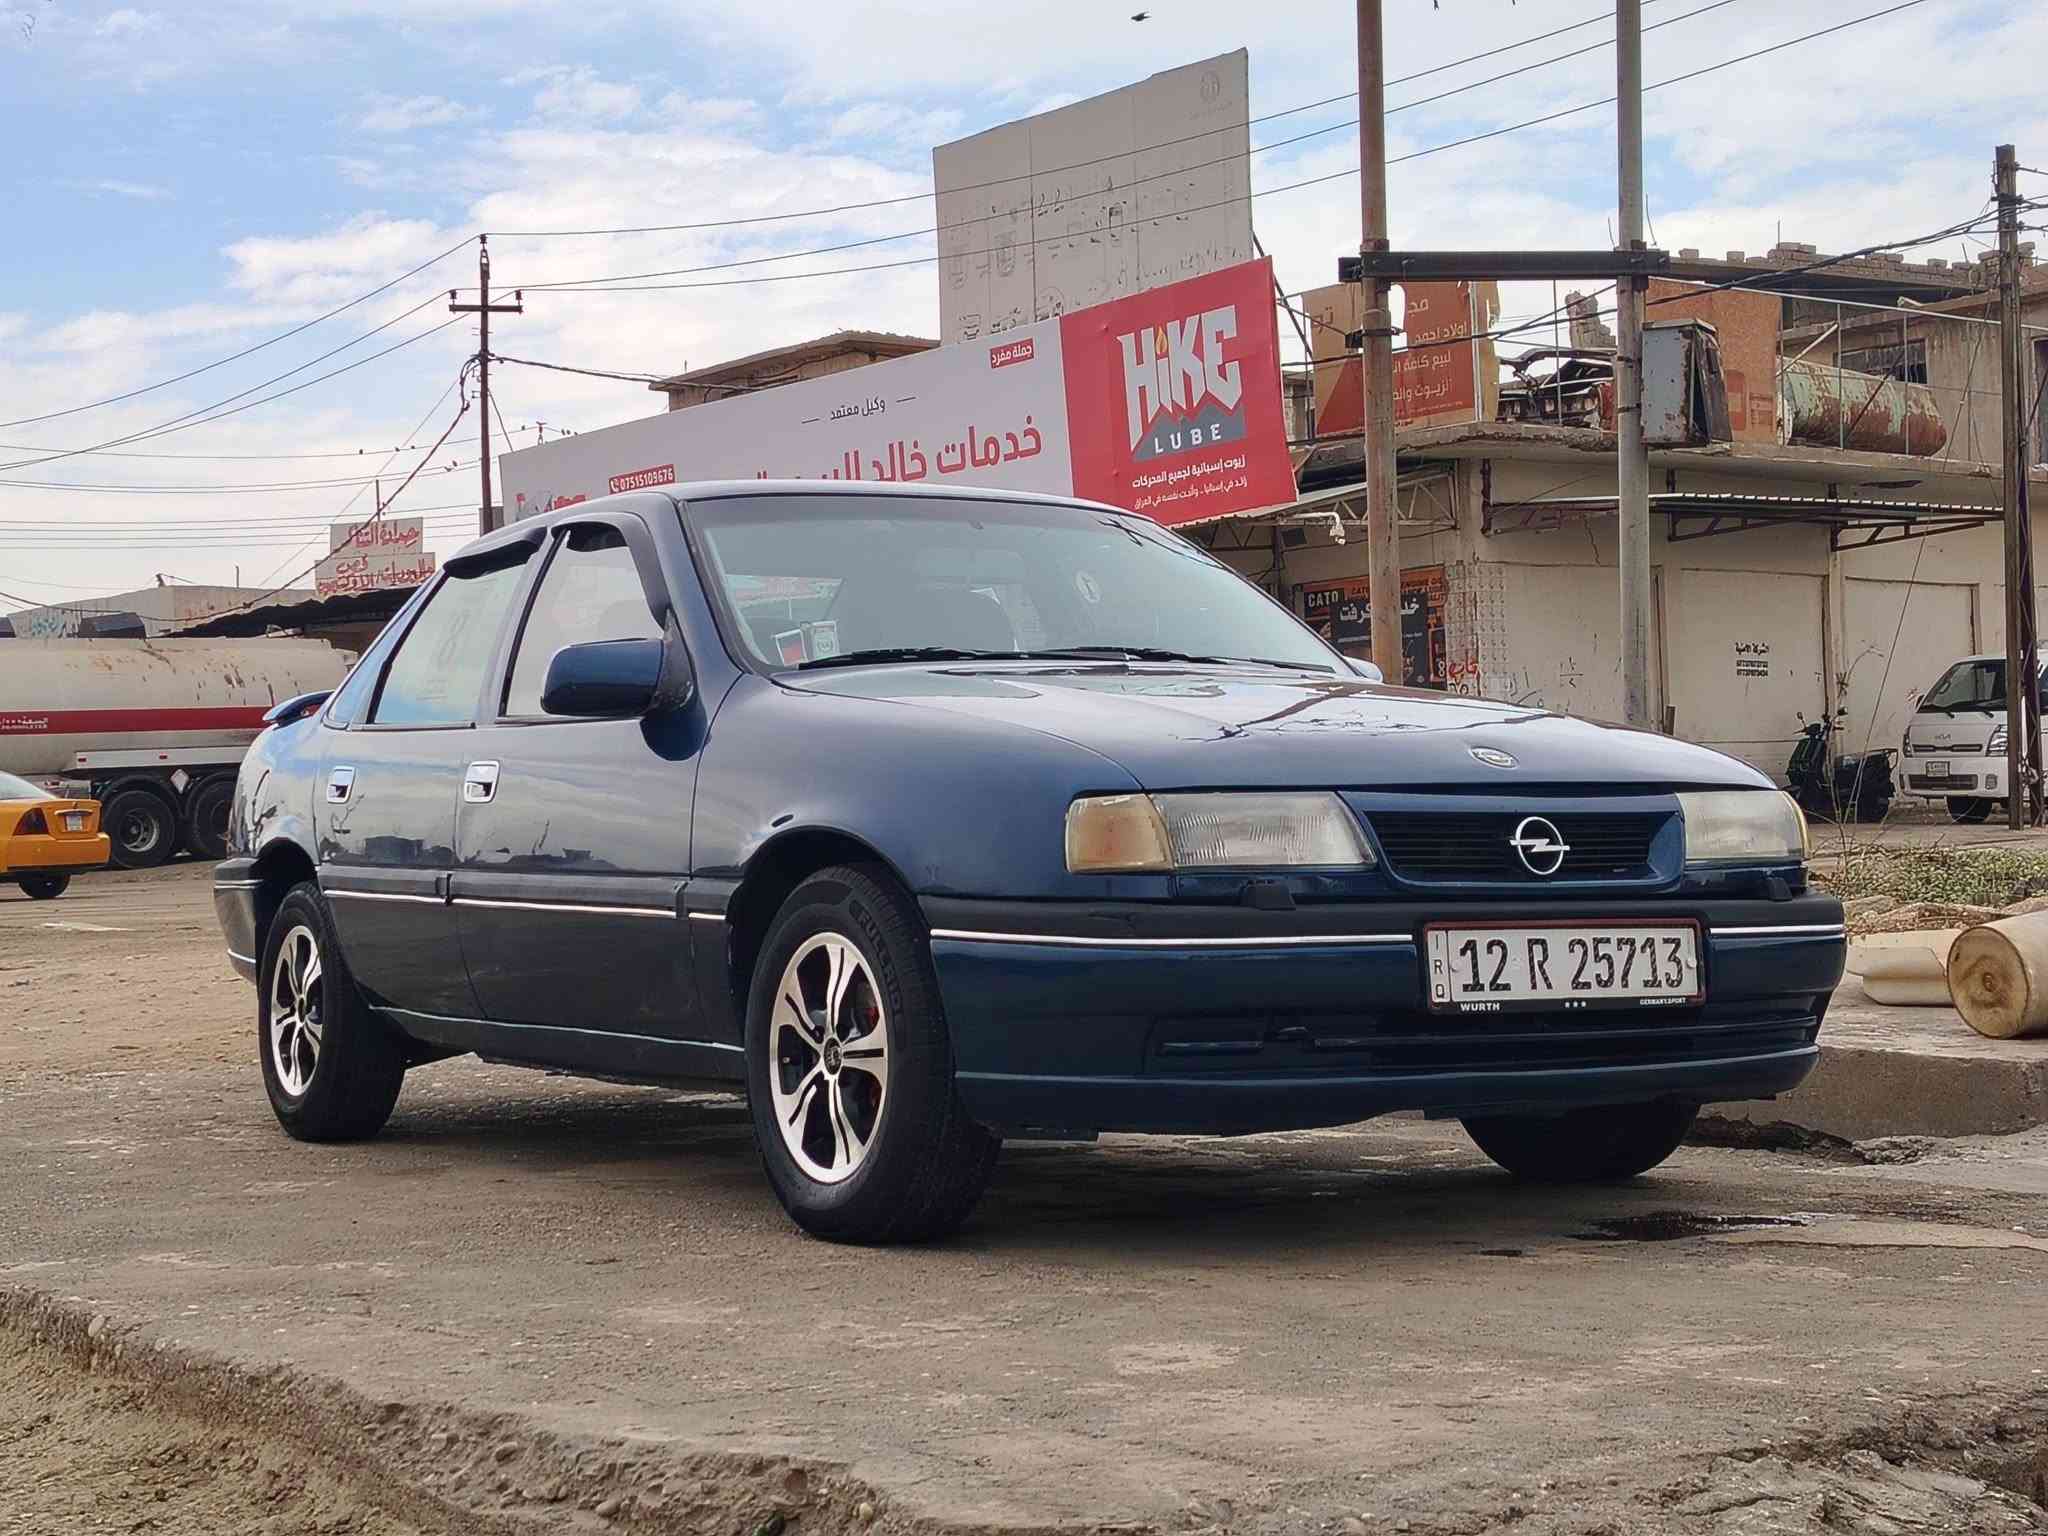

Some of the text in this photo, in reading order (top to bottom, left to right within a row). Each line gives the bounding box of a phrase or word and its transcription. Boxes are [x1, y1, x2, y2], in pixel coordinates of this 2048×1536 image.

[830, 395, 886, 421] وكيل معتمد
[936, 415, 1042, 474] خدمات
[1154, 423, 1222, 454] LUBE
[871, 440, 928, 481] خالد
[1459, 937, 1683, 992] 12 R 25713
[1460, 1002, 1500, 1011] WURTH
